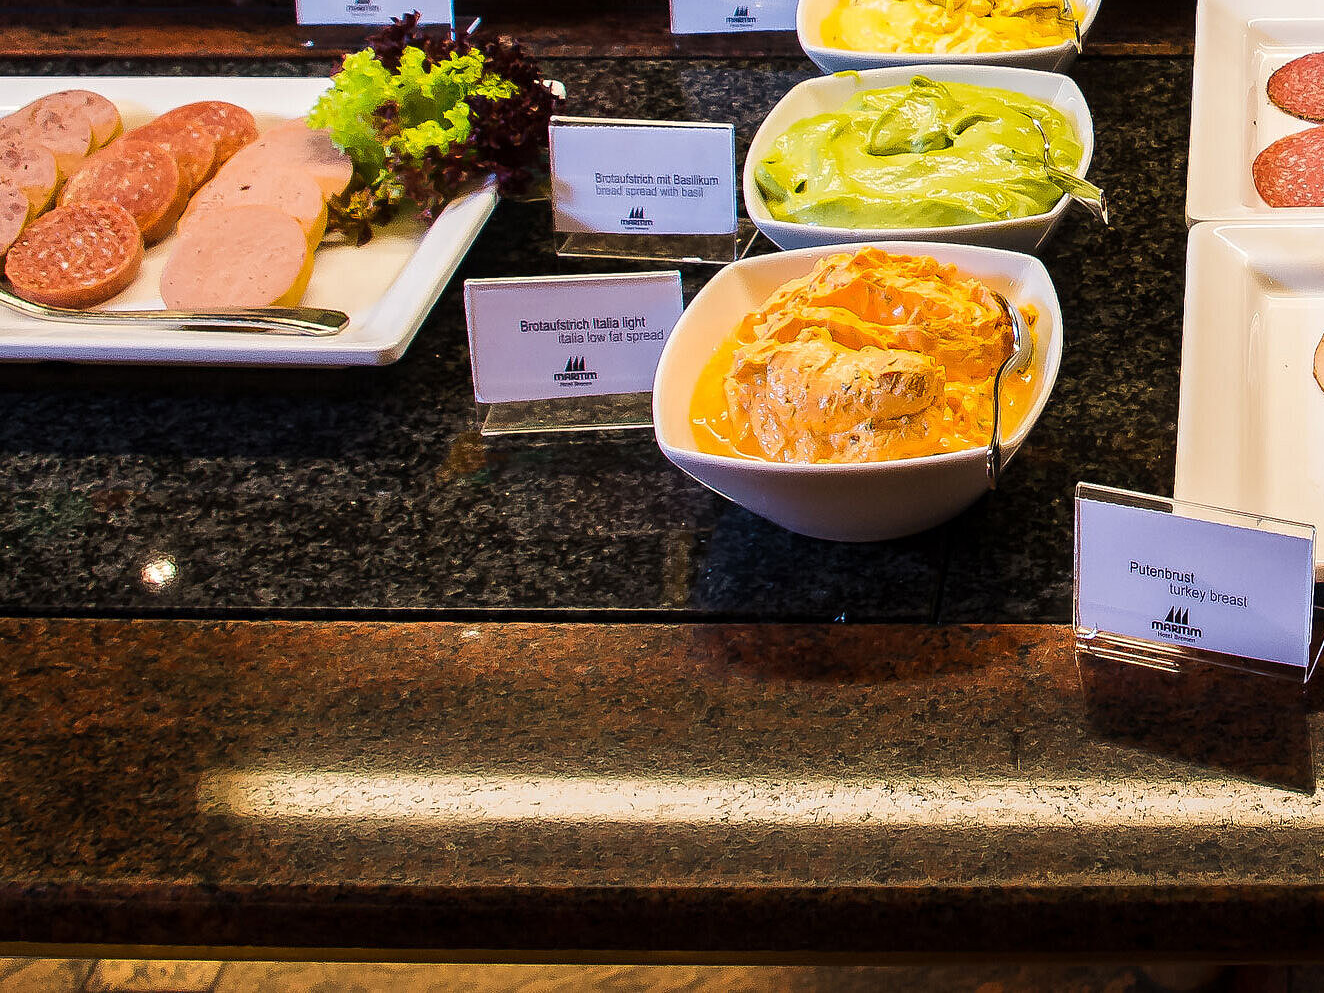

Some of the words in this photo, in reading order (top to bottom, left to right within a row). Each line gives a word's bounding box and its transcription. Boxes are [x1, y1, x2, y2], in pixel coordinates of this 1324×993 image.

[594, 172, 654, 185] Brotaufstrich
[656, 173, 671, 185] mit
[673, 174, 719, 186] Basilikum
[595, 185, 622, 196] bread
[625, 186, 657, 197] spread
[660, 186, 679, 197] with
[682, 187, 704, 198] basil
[520, 318, 589, 332] Brotaufstrich
[593, 317, 620, 330] Italia
[622, 316, 647, 330] light
[558, 331, 584, 344] italia
[586, 331, 606, 343] low
[608, 330, 623, 343] fat
[626, 329, 664, 344] spread
[1130, 560, 1195, 584] Putenbrust
[1169, 583, 1206, 603] turkey
[1210, 590, 1248, 608] breast
